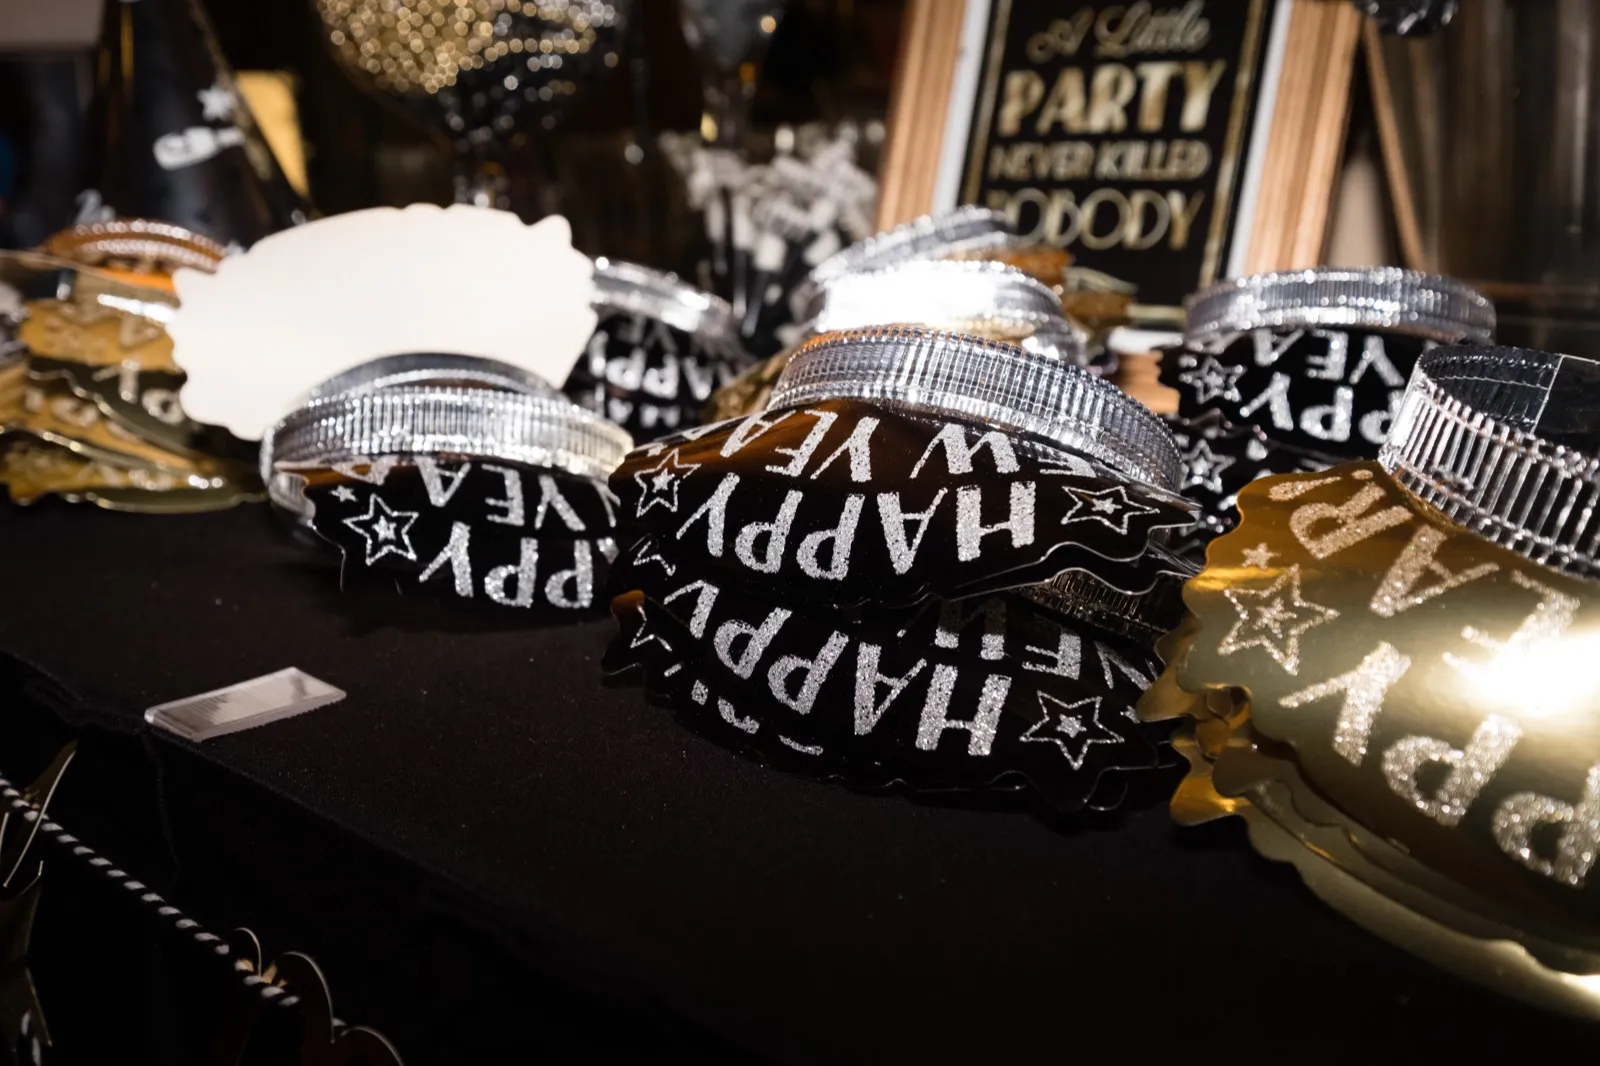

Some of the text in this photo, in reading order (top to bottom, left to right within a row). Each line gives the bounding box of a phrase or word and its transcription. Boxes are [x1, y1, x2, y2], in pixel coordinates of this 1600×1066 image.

[1093, 0, 1210, 57] Little
[998, 60, 1226, 136] PARTY
[987, 139, 1212, 180] NEVER KILLED
[676, 472, 1037, 581] HAPPY
